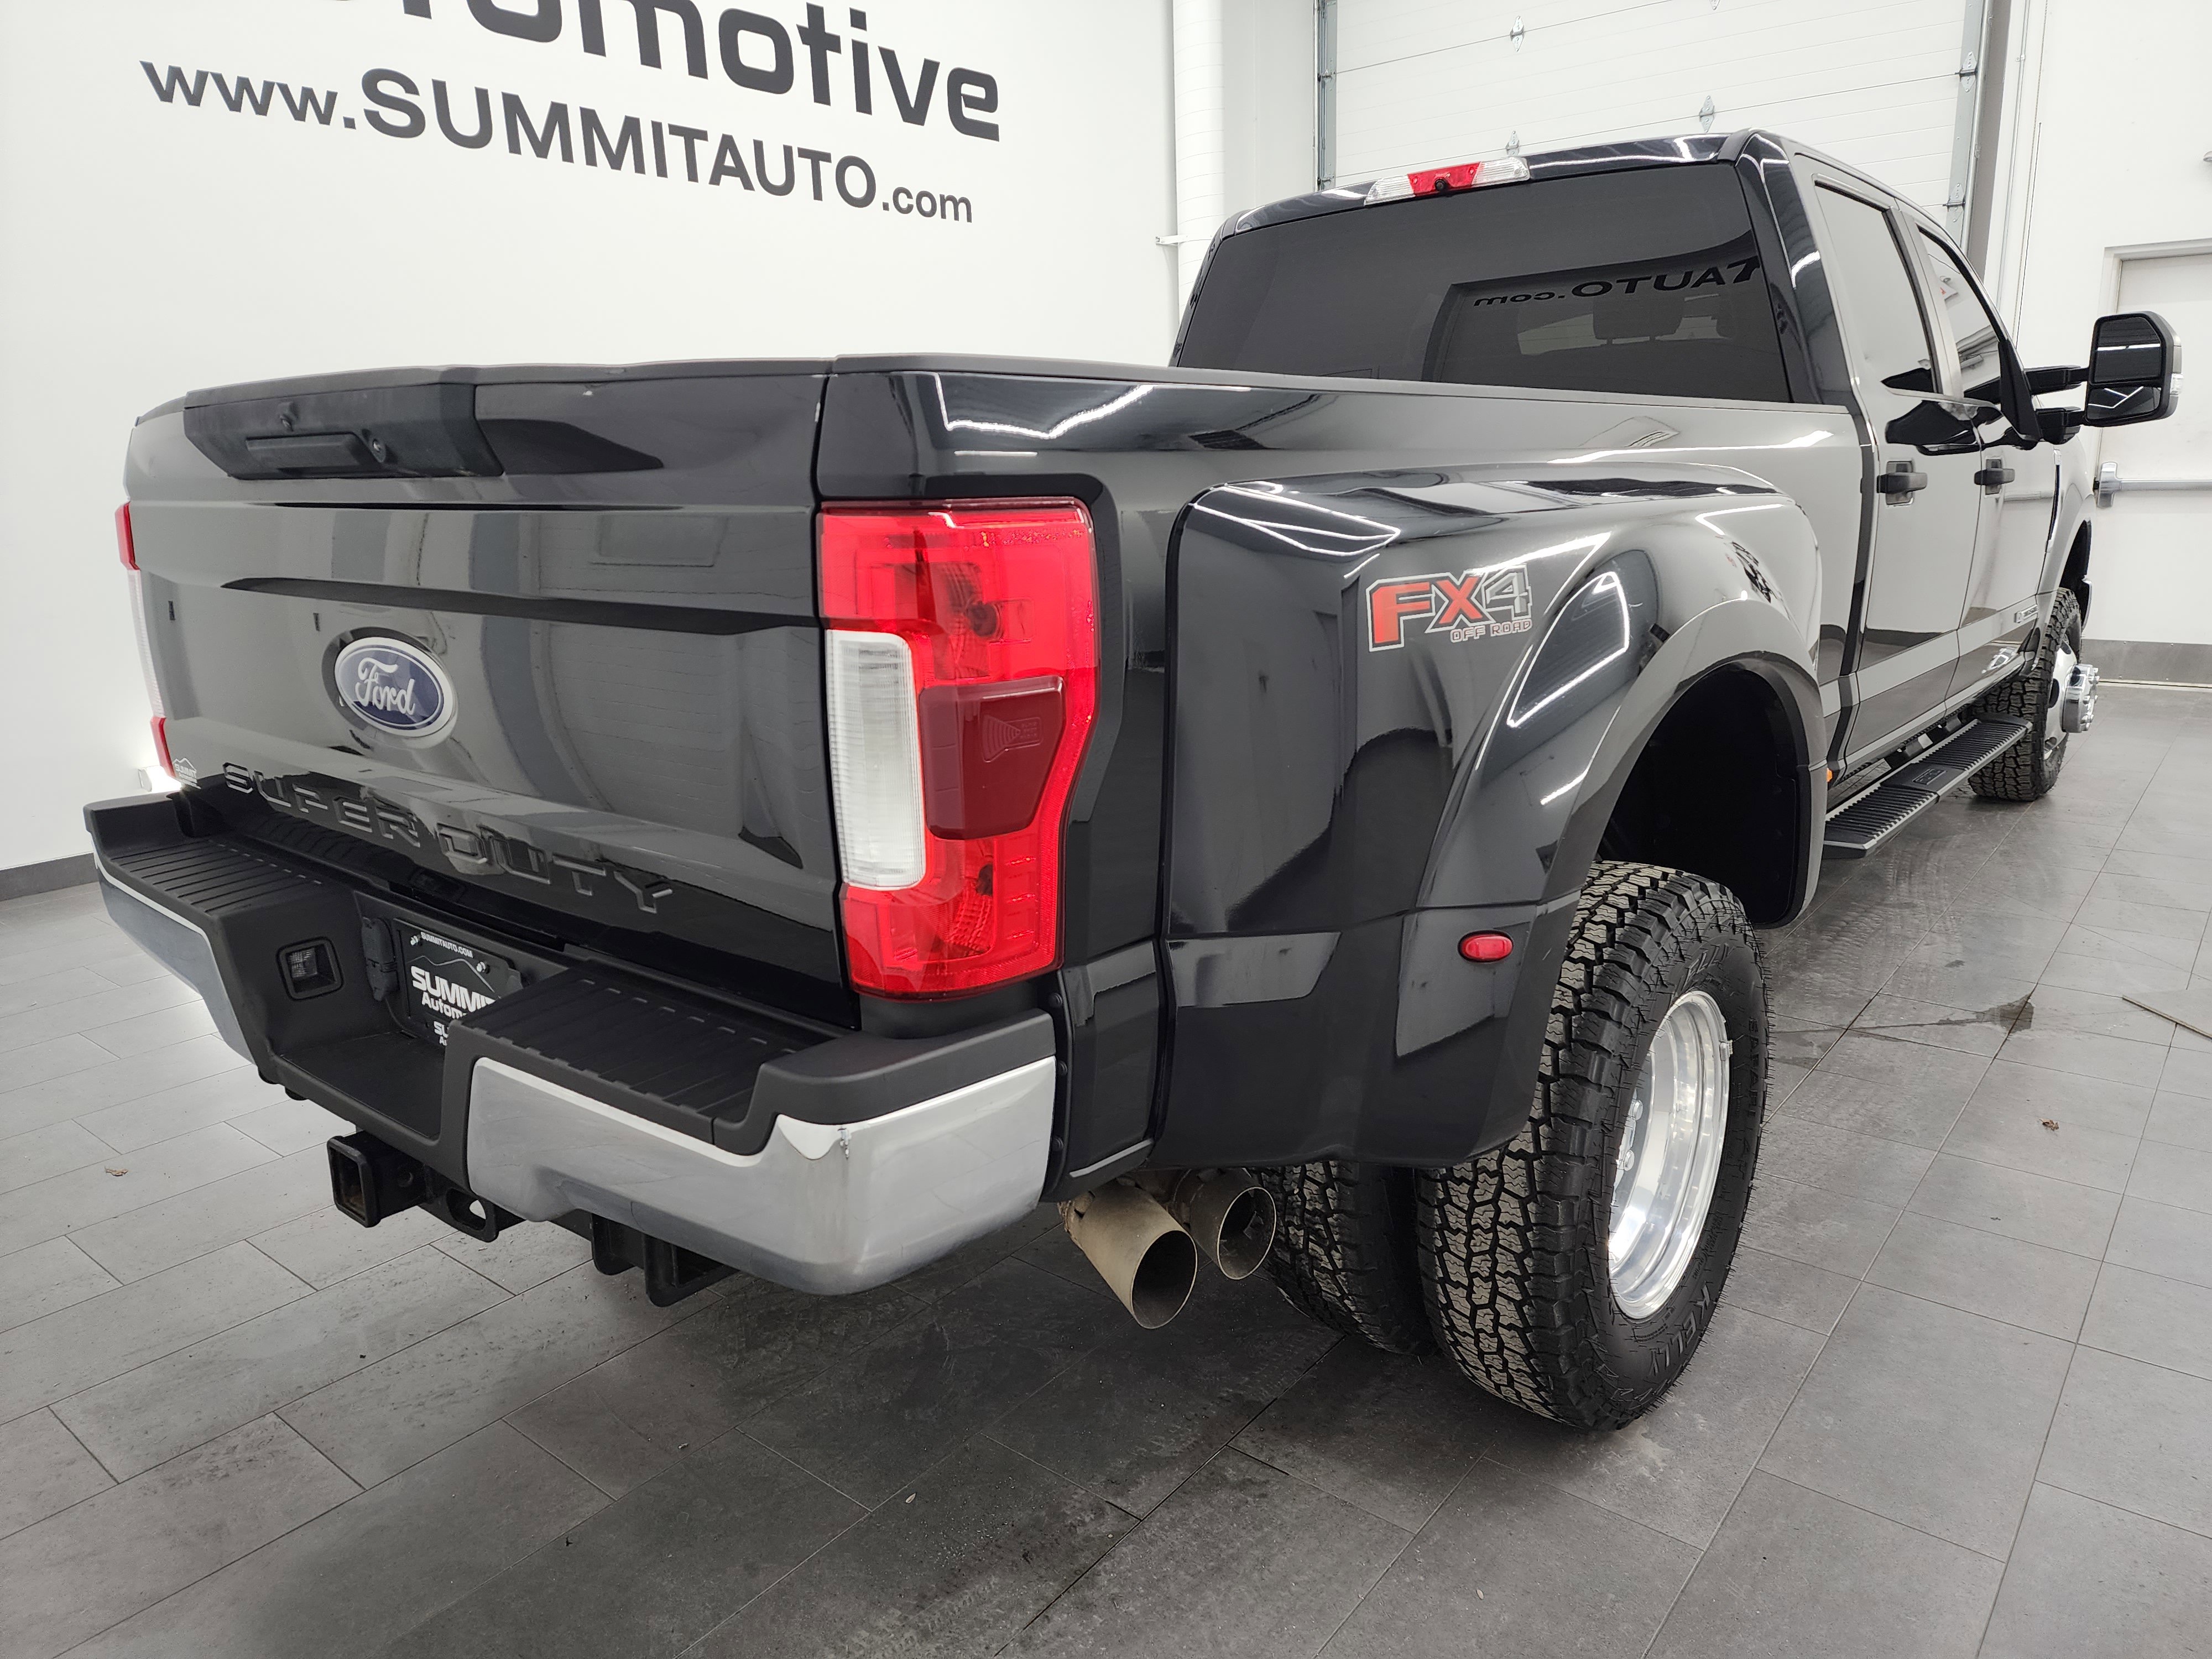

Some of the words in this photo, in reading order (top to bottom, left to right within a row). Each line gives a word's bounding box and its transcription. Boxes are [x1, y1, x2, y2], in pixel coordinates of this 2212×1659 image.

[403, 0, 1000, 142] motive
[139, 61, 972, 223] www.SUMMITAUTO.com
[1365, 564, 1532, 652] FX4
[1451, 625, 1486, 643] OFF
[1490, 618, 1533, 637] ROAD
[355, 657, 416, 715] Ford
[222, 761, 421, 848] SUPER
[436, 822, 674, 914] DUTY
[420, 931, 473, 958] SUMMITAUTO.COM
[411, 966, 496, 1013] SUMM
[421, 992, 468, 1019] Autom
